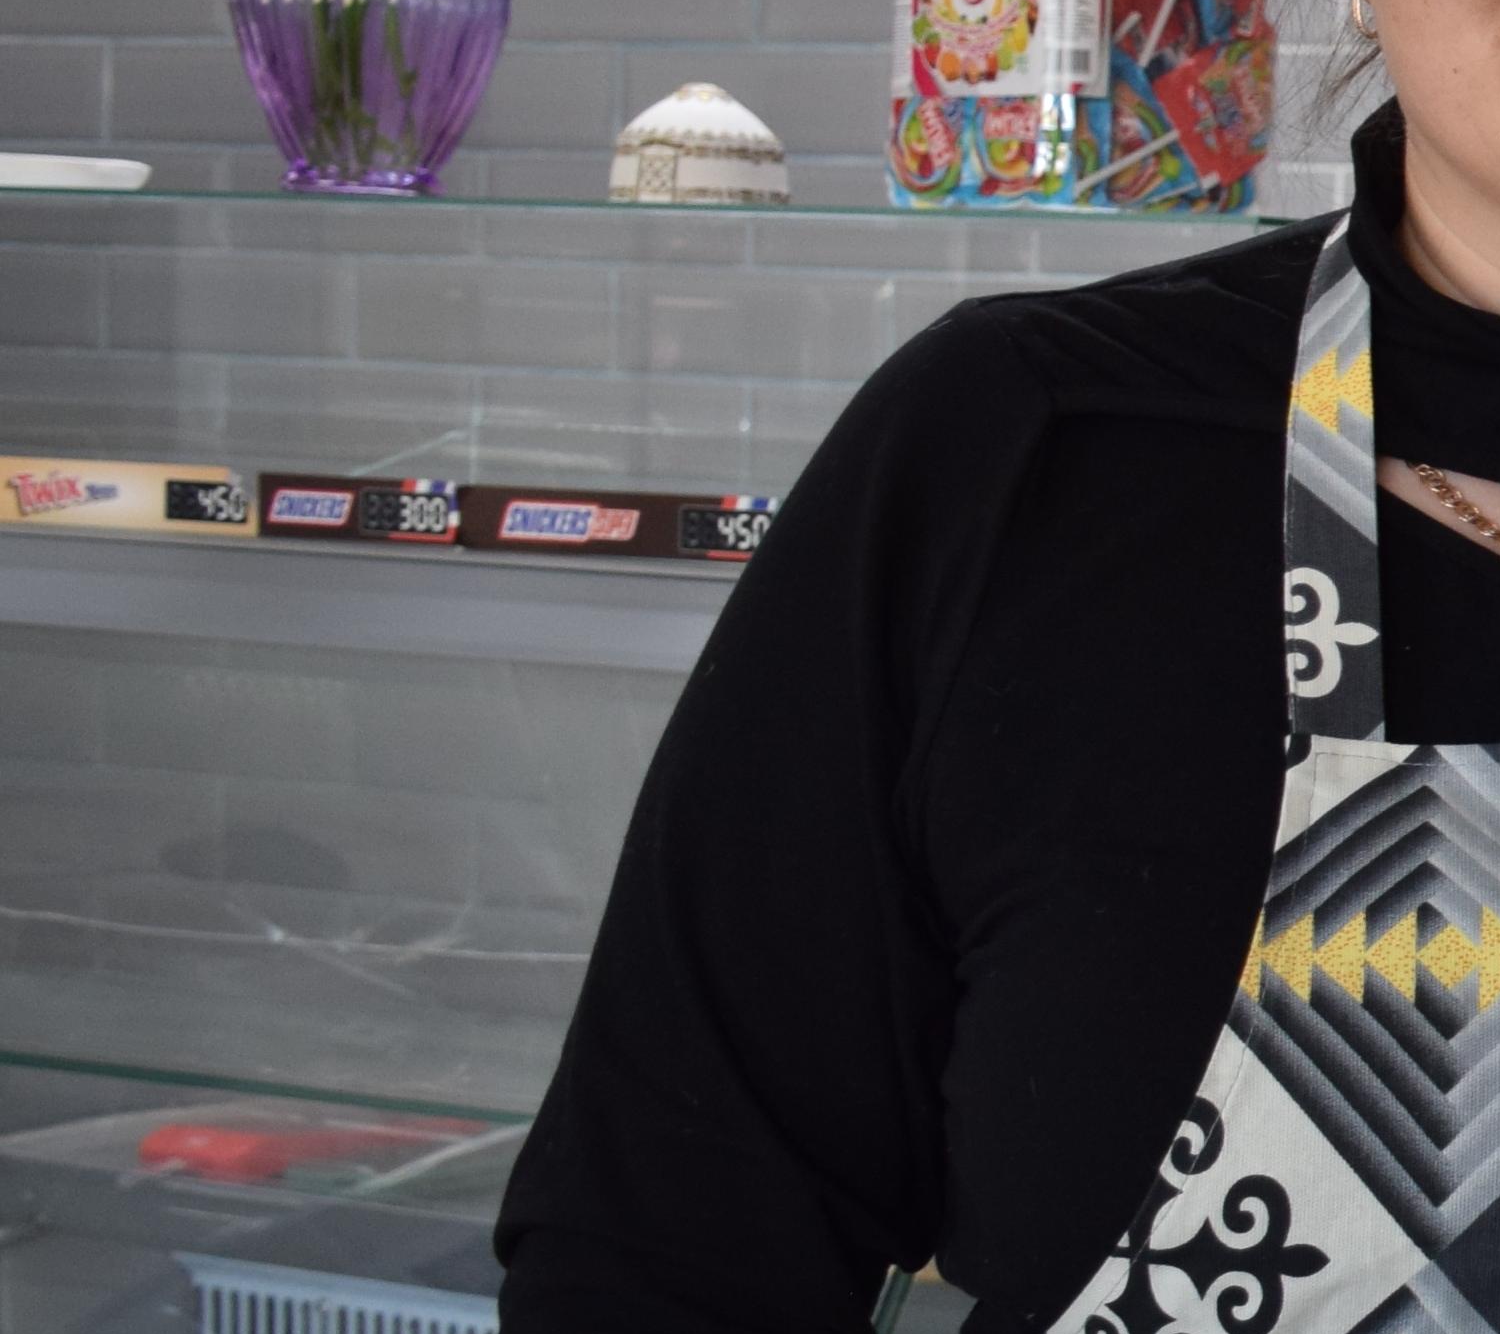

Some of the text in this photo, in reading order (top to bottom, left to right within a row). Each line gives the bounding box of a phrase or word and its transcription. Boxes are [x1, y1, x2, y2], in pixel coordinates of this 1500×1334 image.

[197, 486, 247, 522] 450
[275, 494, 447, 533] SNICKERS 300
[504, 505, 594, 537] SNICKERS
[716, 513, 772, 550] 450
